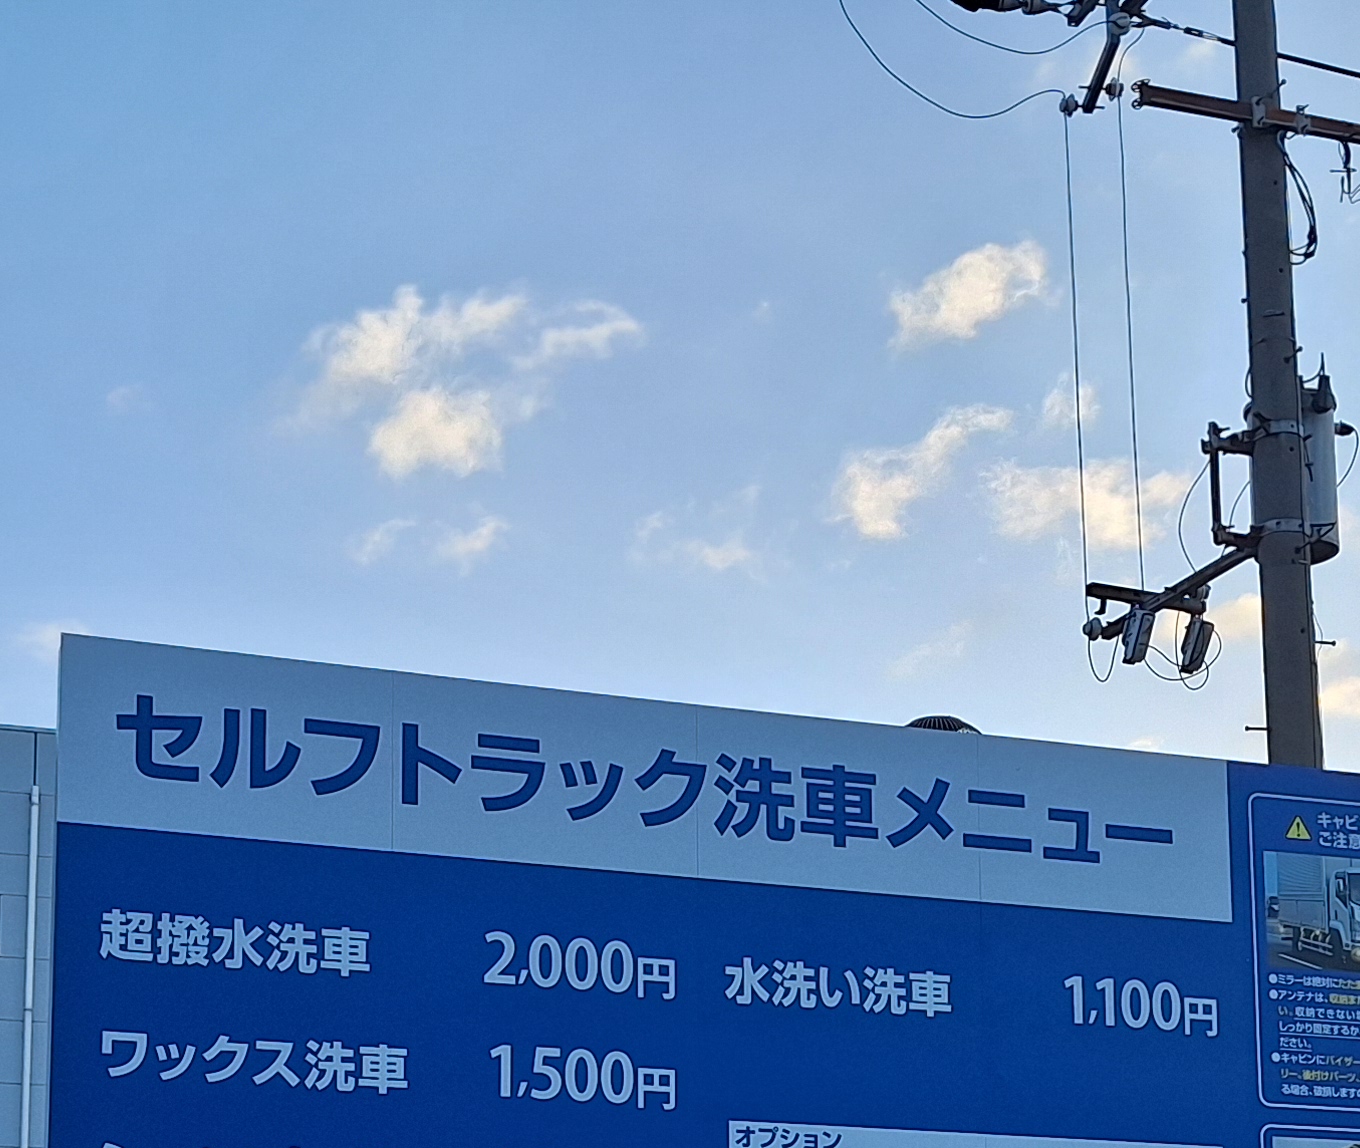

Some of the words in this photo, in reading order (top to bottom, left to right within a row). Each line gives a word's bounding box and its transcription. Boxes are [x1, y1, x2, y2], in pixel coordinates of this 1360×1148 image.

[115, 693, 1174, 864] セルフトラック洗車メニュー
[99, 908, 371, 978] 超撥水洗車
[483, 930, 677, 1000] 2,000円
[724, 957, 952, 1017] 水洗い洗車
[1064, 975, 1219, 1038] 1,100円
[100, 1030, 409, 1095] ワックス洗車
[489, 1043, 677, 1111] 1,500円
